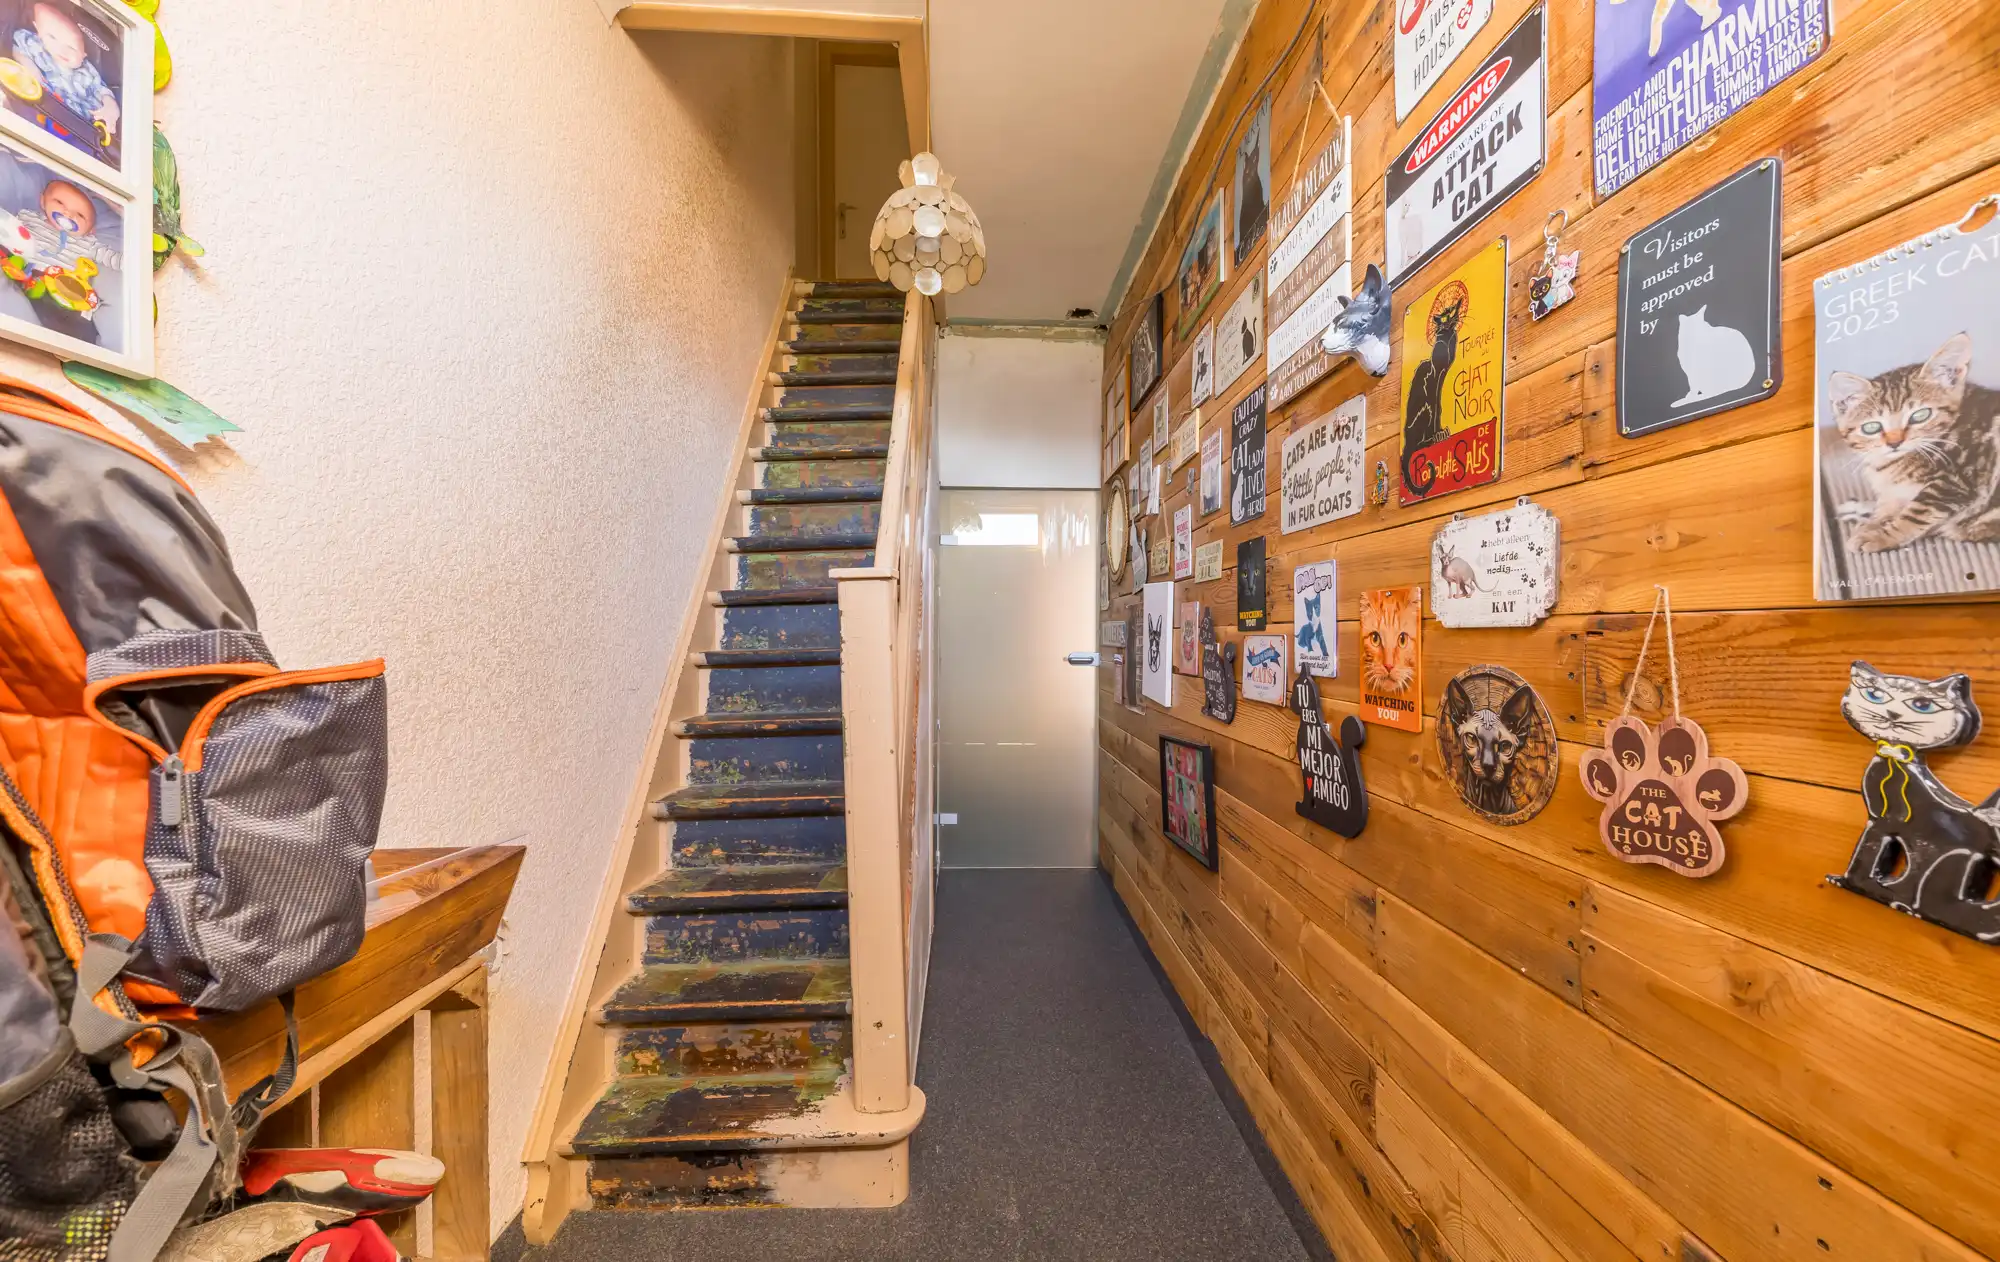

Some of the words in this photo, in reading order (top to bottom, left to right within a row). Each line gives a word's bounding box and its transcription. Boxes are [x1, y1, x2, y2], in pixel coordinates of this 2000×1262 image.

[1413, 21, 1455, 91] HOUSE
[1414, 29, 1426, 52] is
[1713, 37, 1762, 88] ENJOYS
[1765, 9, 1799, 51] LOTS
[1713, 56, 1762, 103] TUMMY
[1765, 13, 1823, 69] TICKLES
[1413, 69, 1498, 167] WARNING
[1595, 87, 1642, 136] FRIENDLY
[1644, 68, 1666, 98] AND
[1446, 119, 1489, 164] BEWARE
[1490, 102, 1506, 124] OF
[1595, 121, 1625, 156] HOME
[1627, 88, 1667, 133] LOVING
[1595, 76, 1714, 186] DELIGHTFUL
[1618, 165, 1635, 186] CAN
[1637, 149, 1660, 174] HAVE
[1661, 133, 1679, 155] HOT
[1681, 101, 1728, 142] TEMPERS
[1730, 74, 1764, 110] WHEN
[1432, 100, 1524, 210] ATTACK
[1270, 179, 1303, 246] MIAUW
[1304, 129, 1344, 204] MIAUW
[1451, 161, 1498, 222] CAT
[1310, 231, 1333, 271] POTEN
[1643, 218, 1720, 260] Visitors
[1641, 261, 1680, 290] must
[1683, 251, 1704, 269] be
[1641, 264, 1715, 314] approved
[1824, 264, 1928, 319] GREEK
[1640, 319, 1659, 335] by
[1825, 300, 1900, 344] 2023
[1453, 361, 1492, 398] CHAT
[1454, 388, 1495, 424] NOIR
[1239, 414, 1258, 439] CRAZY
[1478, 424, 1490, 438] DE
[1231, 438, 1251, 475] CAT
[1249, 446, 1265, 470] LADY
[1286, 438, 1305, 470] CATS
[1307, 425, 1327, 453] ARE
[1243, 468, 1265, 500] LIVES
[1292, 467, 1313, 500] little
[1314, 444, 1346, 500] people
[1247, 496, 1264, 517] HERE
[1288, 510, 1297, 527] IN
[1298, 503, 1315, 524] FUR
[1318, 490, 1352, 517] COATS
[1494, 552, 1519, 563] Liefde
[1313, 574, 1333, 594] OP!
[1507, 588, 1523, 596] een
[1829, 578, 1860, 589] WALL
[1864, 572, 1934, 587] CALENDAR
[1491, 600, 1516, 614] KAT
[1251, 667, 1273, 685] CATS
[1296, 679, 1309, 708] TÚ
[1302, 710, 1317, 724] ERES
[1364, 693, 1415, 713] WATCHING
[1377, 707, 1400, 722] YOU!
[1306, 725, 1322, 751] MI
[1301, 748, 1342, 784] MEJOR
[1313, 776, 1349, 811] AMIGO
[1639, 786, 1667, 799] THE
[1625, 800, 1682, 831] CAT
[1612, 825, 1709, 861] HOUSE
